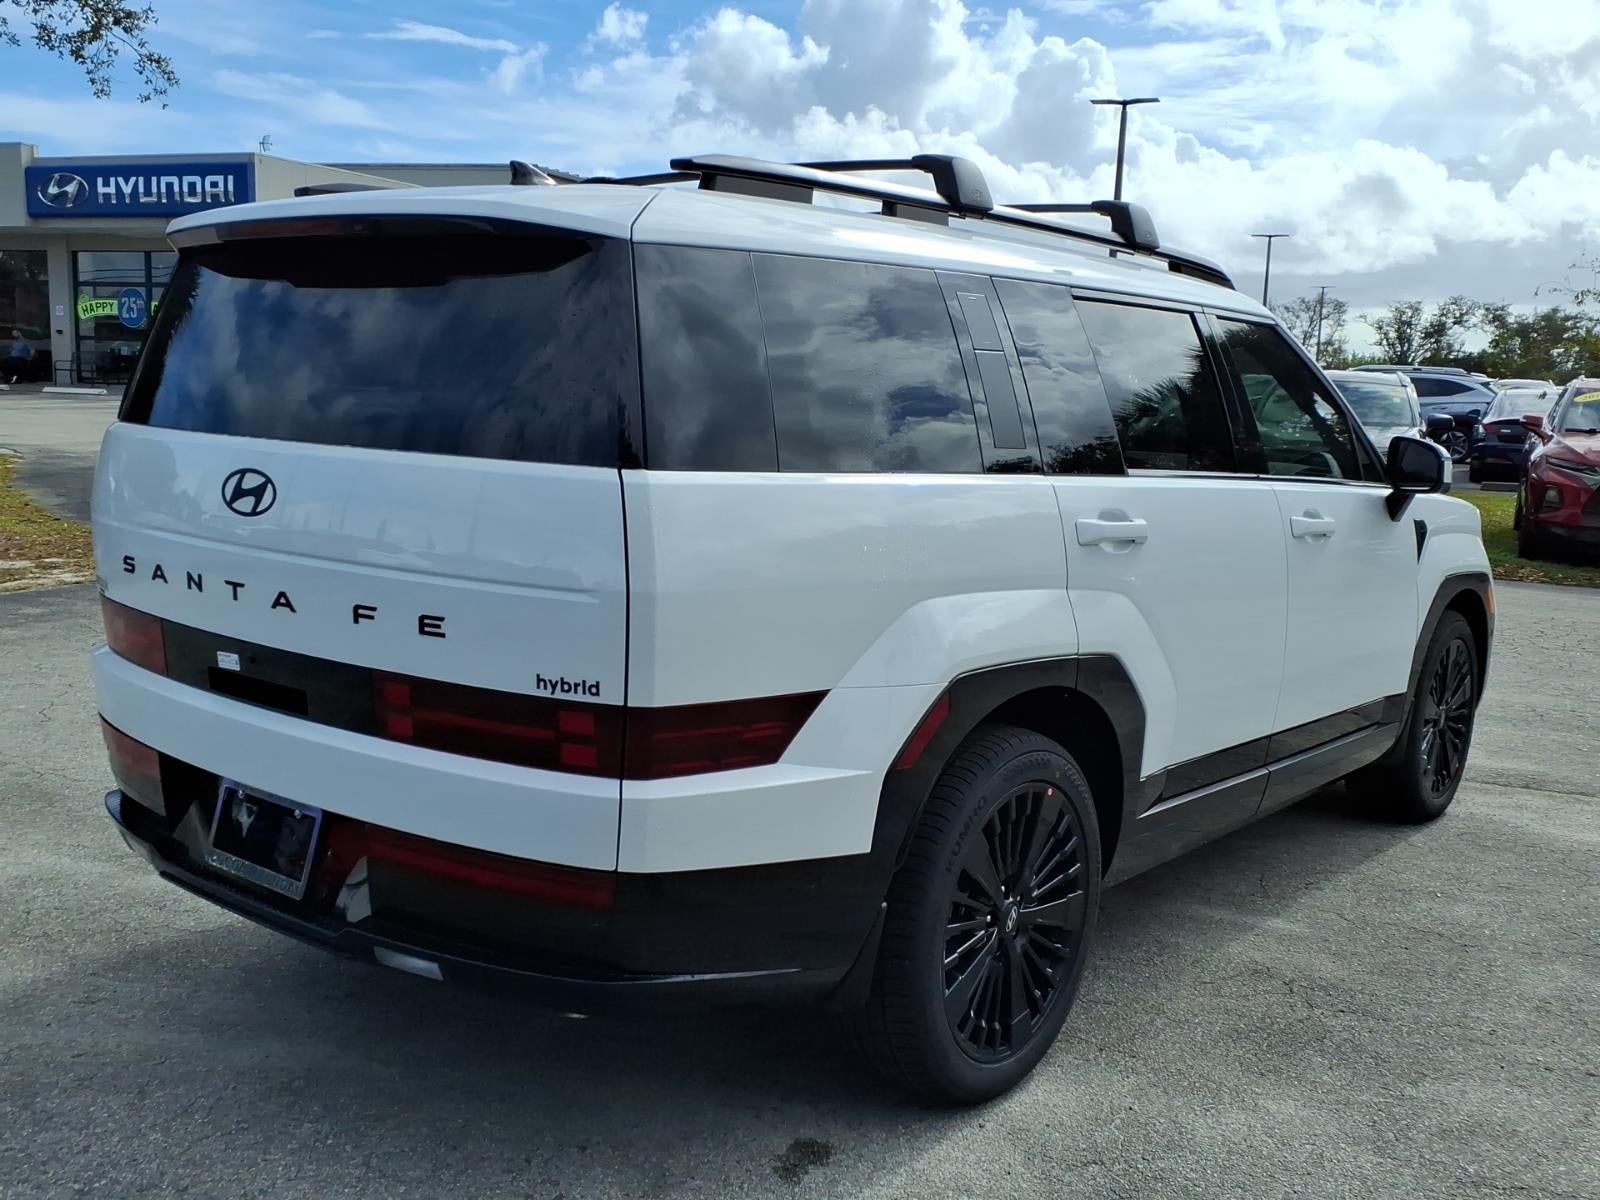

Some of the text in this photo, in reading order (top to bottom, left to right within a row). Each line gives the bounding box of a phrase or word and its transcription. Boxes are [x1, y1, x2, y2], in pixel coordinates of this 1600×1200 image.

[97, 175, 235, 203] HYUNDAI
[81, 302, 115, 317] HAPPY
[121, 297, 145, 319] 25th
[122, 555, 447, 639] SANTA FE
[535, 674, 600, 698] hybrid
